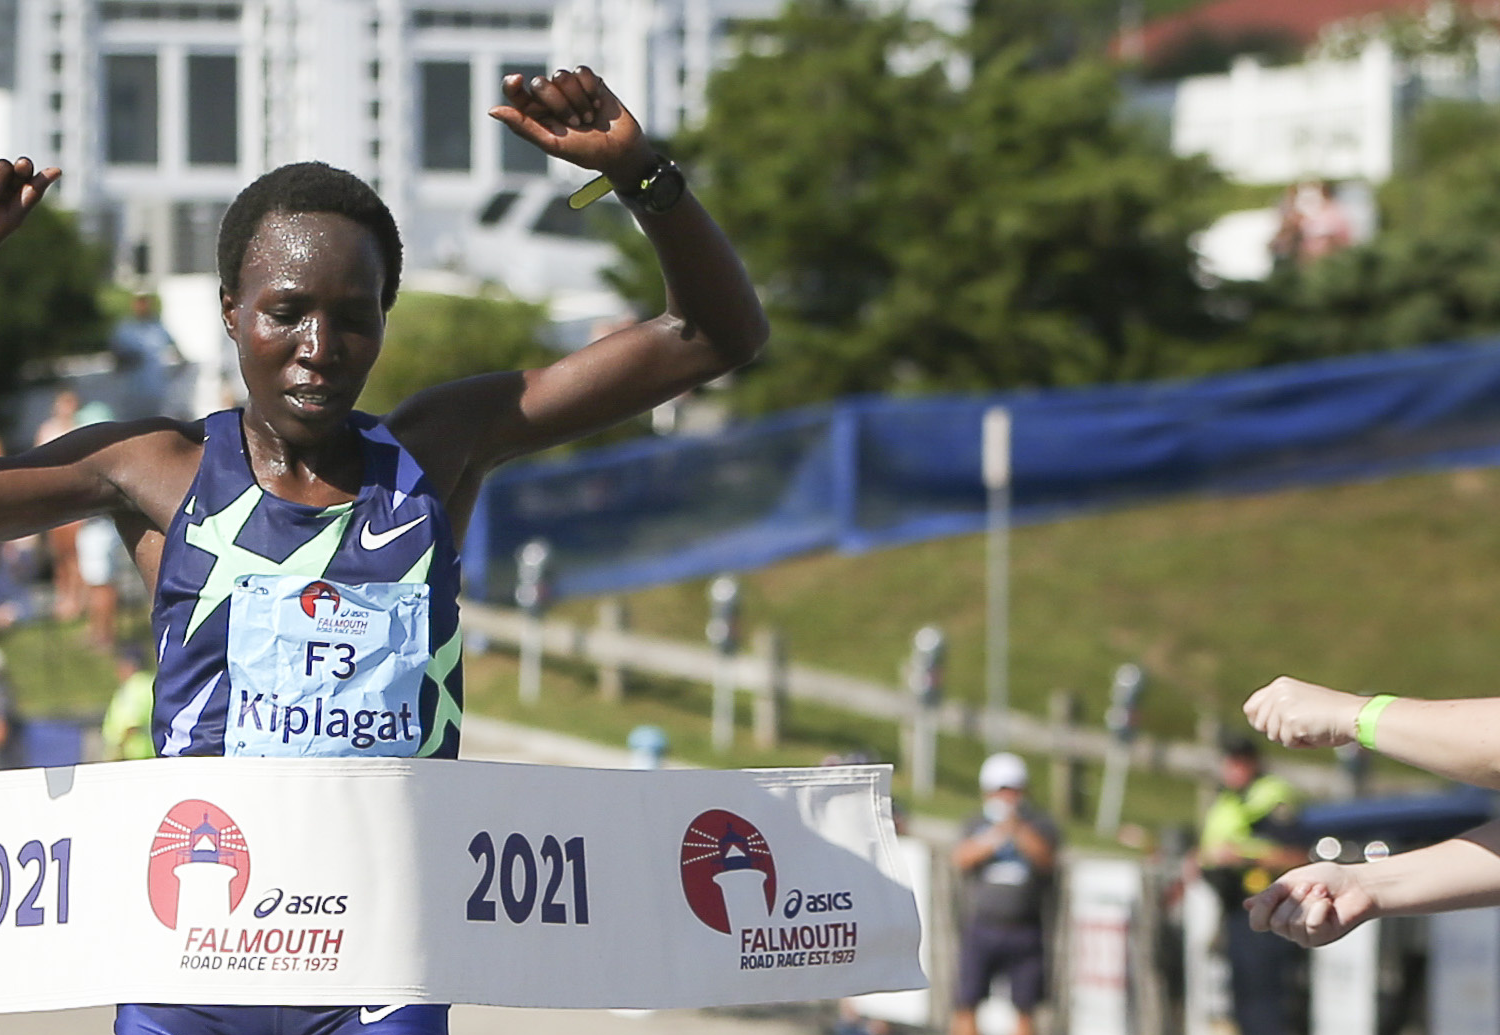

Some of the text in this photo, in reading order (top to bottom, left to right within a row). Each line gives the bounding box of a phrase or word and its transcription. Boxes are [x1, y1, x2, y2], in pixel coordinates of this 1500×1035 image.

[317, 617, 368, 629] FALMOUTH
[305, 641, 356, 680] F3
[237, 690, 415, 749] Kiplagat
[467, 832, 589, 925] 2021
[185, 927, 344, 954] FALMOUTH
[741, 922, 857, 953] FALMOUTH
[180, 955, 223, 970] ROAD
[227, 956, 268, 971] RACE
[740, 954, 775, 970] ROAD
[777, 951, 806, 968] RACE
